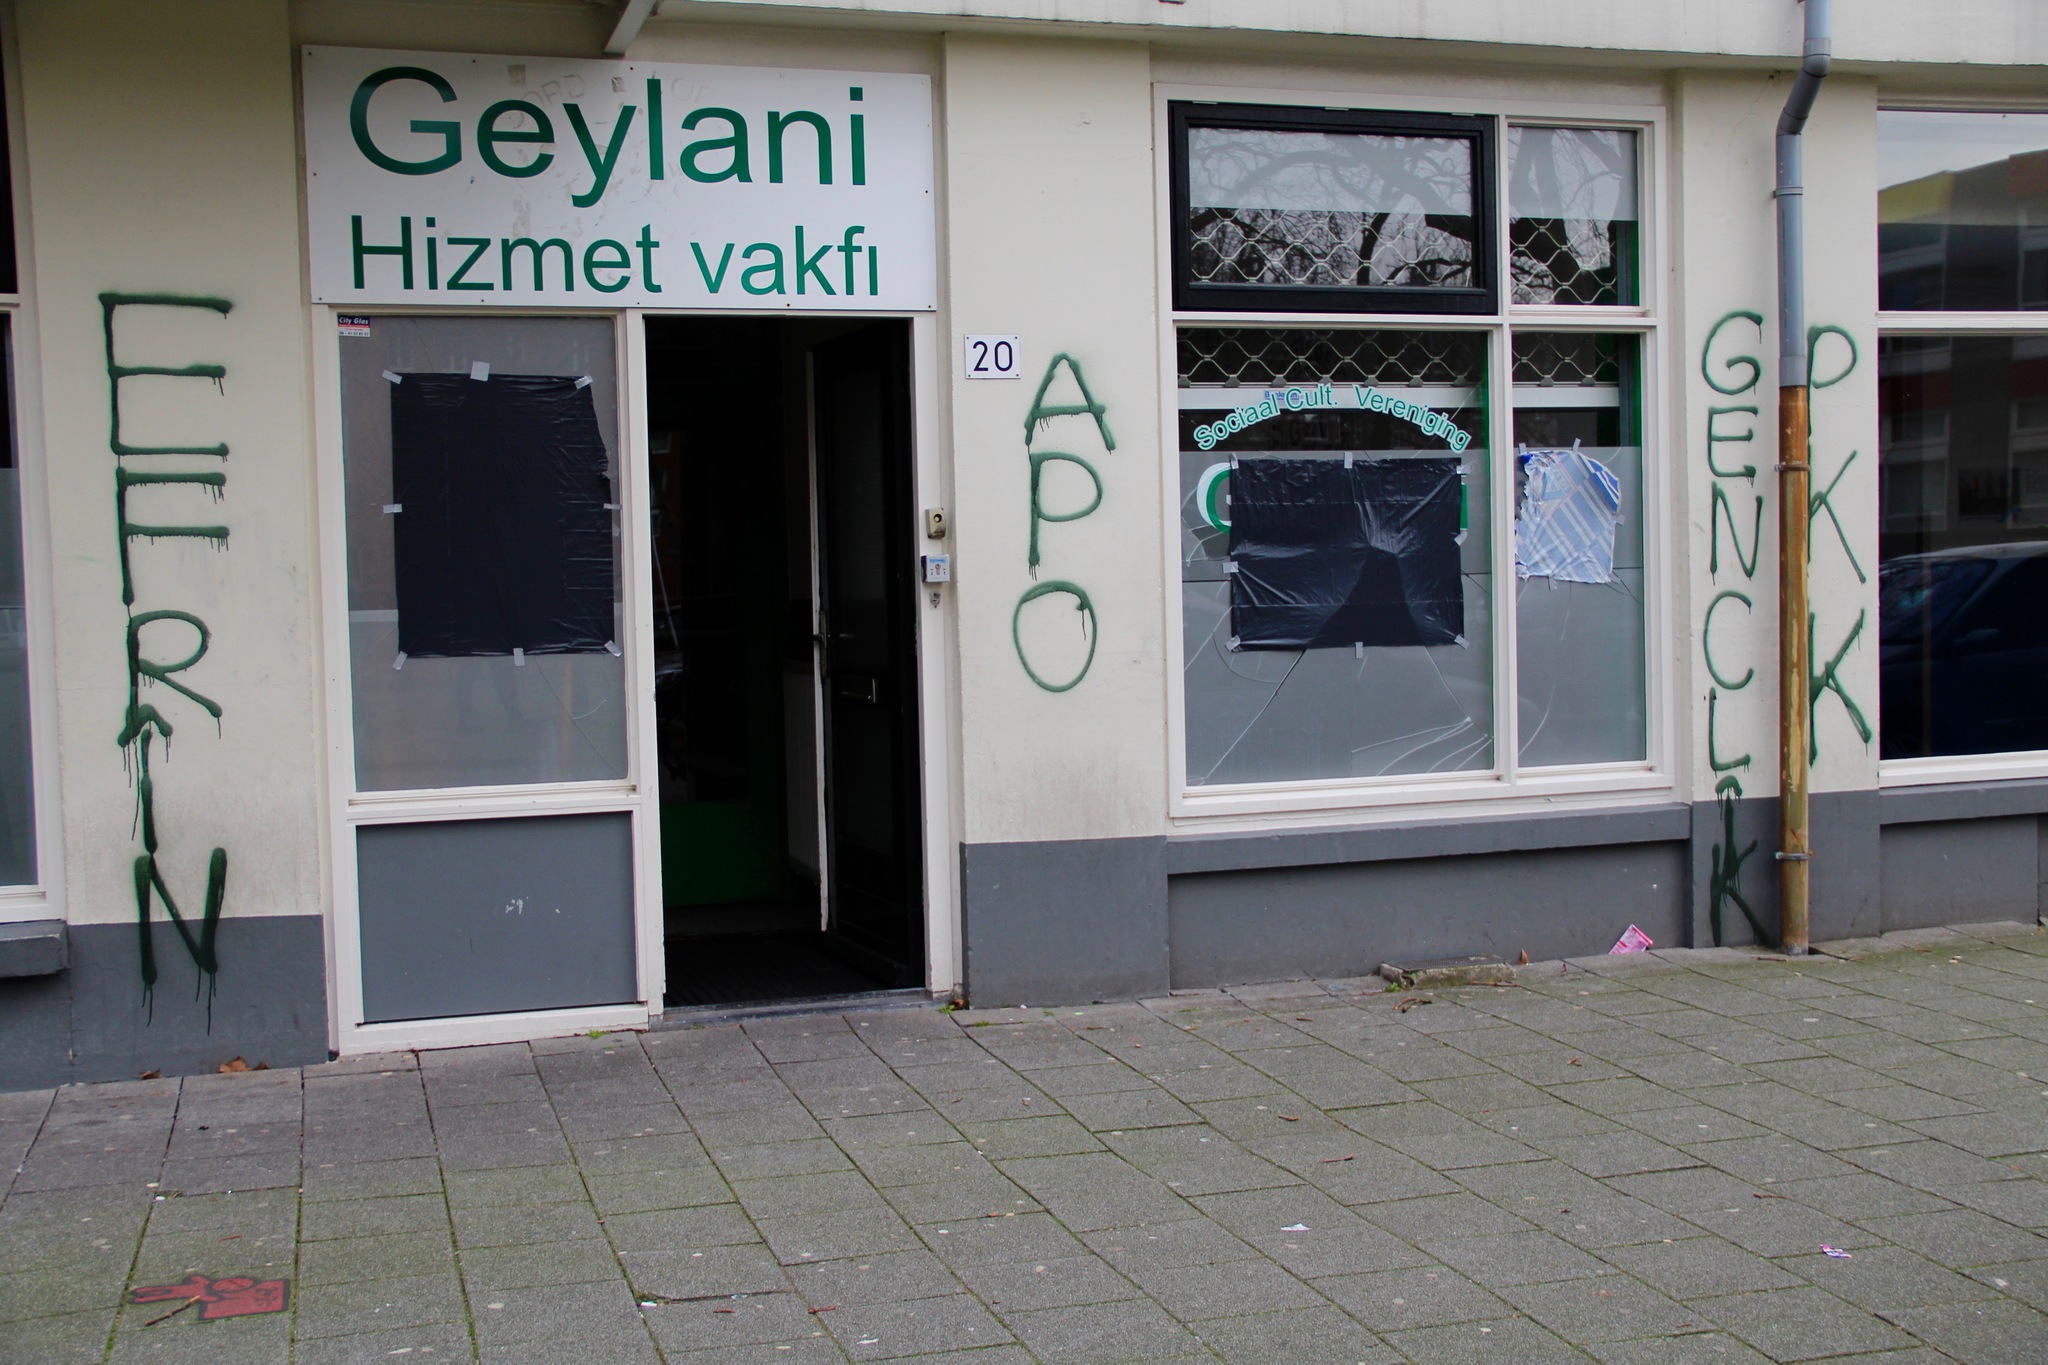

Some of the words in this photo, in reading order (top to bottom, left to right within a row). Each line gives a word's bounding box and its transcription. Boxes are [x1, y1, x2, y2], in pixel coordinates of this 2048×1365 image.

[349, 65, 867, 208] Geylani
[350, 214, 663, 294] Hizmet
[339, 317, 352, 325] City
[353, 317, 369, 325] Glas
[972, 340, 1013, 372] 20
[1193, 393, 1282, 450] Sociaal
[1284, 383, 1338, 412] Cult.
[1352, 384, 1473, 454] Vereniging
[1011, 352, 1116, 693] APO
[1806, 324, 1872, 768] PKK
